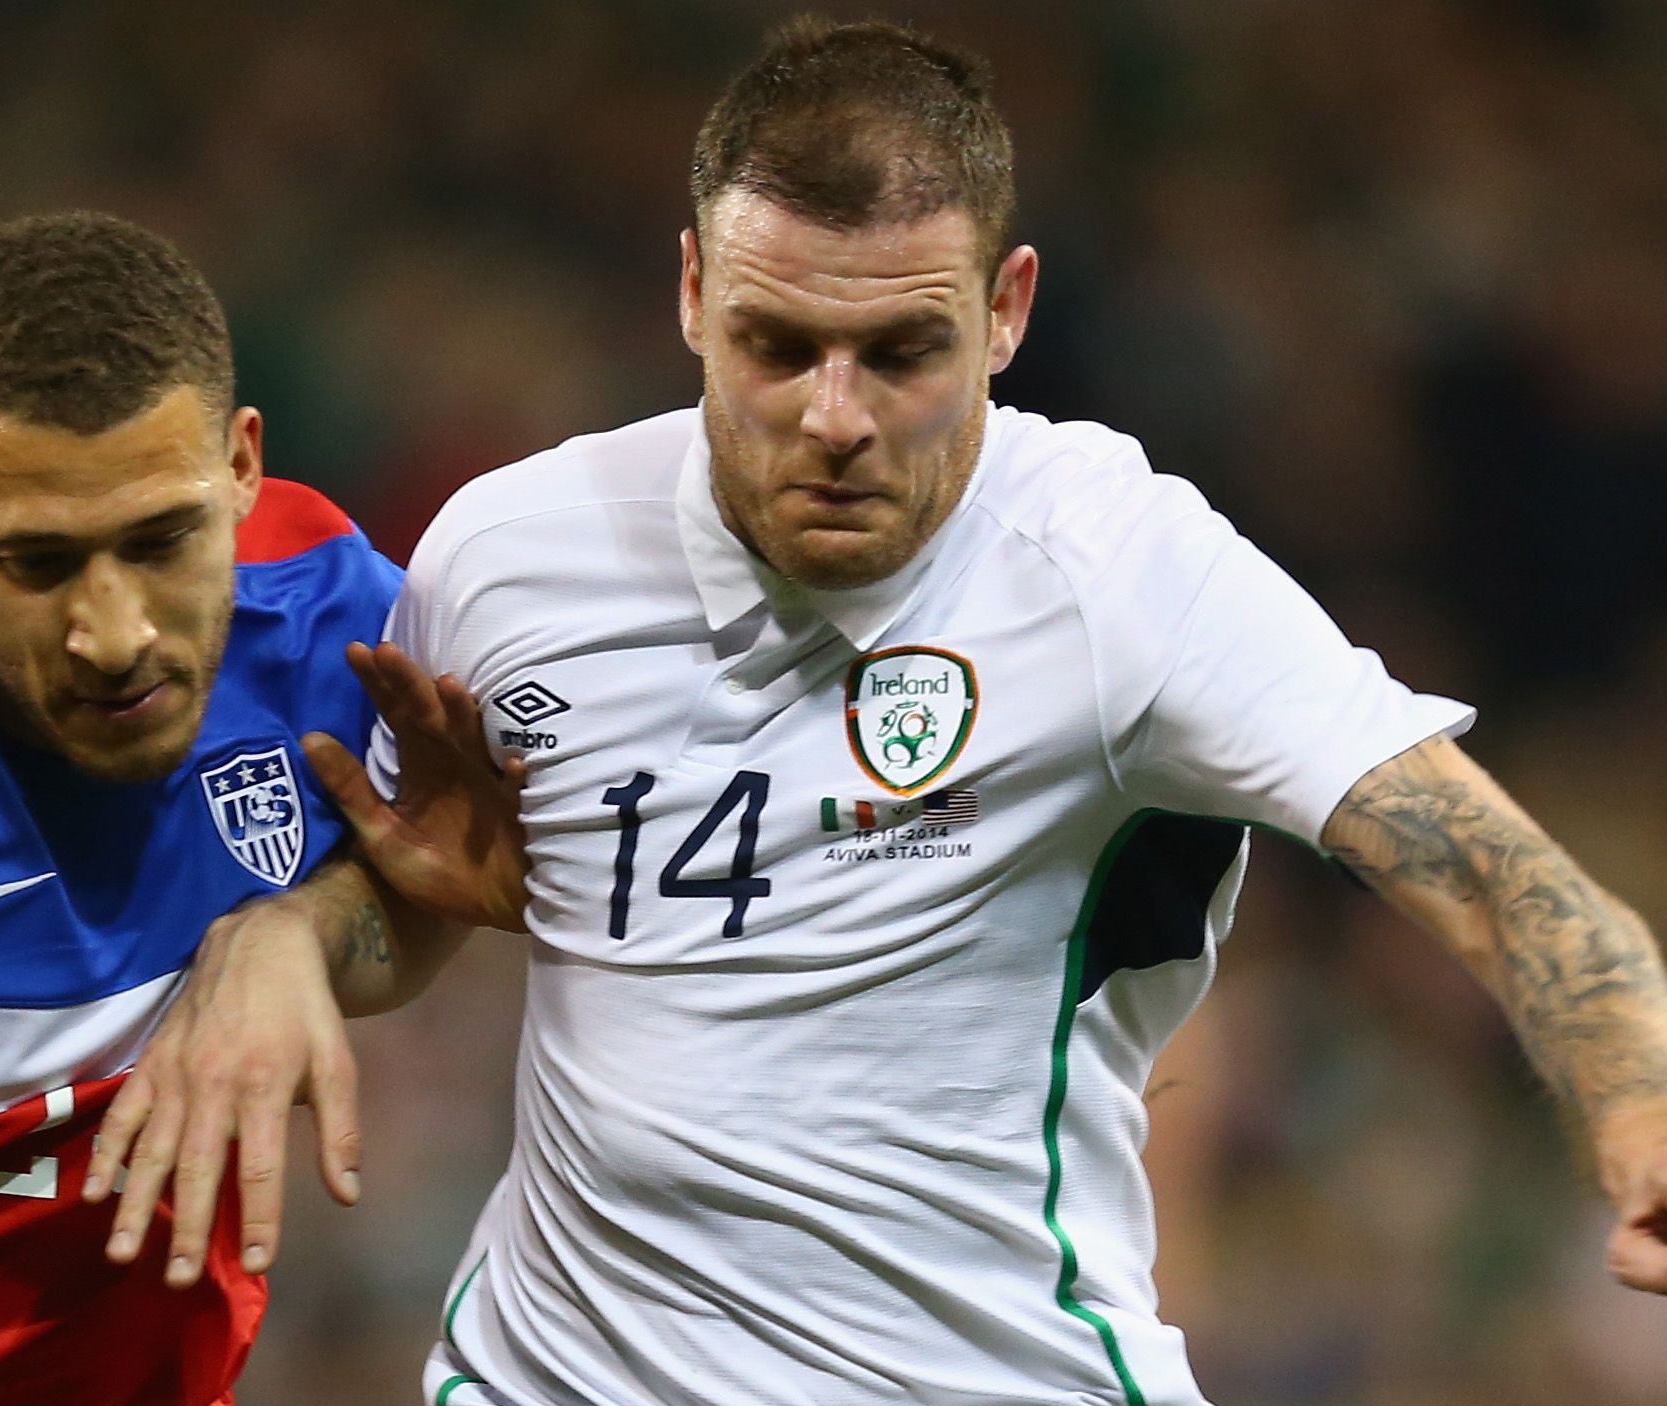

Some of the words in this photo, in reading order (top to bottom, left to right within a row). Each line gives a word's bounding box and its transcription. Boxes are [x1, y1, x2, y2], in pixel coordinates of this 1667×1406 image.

[869, 671, 950, 697] Ireland
[602, 770, 771, 940] 14
[823, 846, 879, 861] AVIVA
[884, 843, 972, 860] STADIUM
